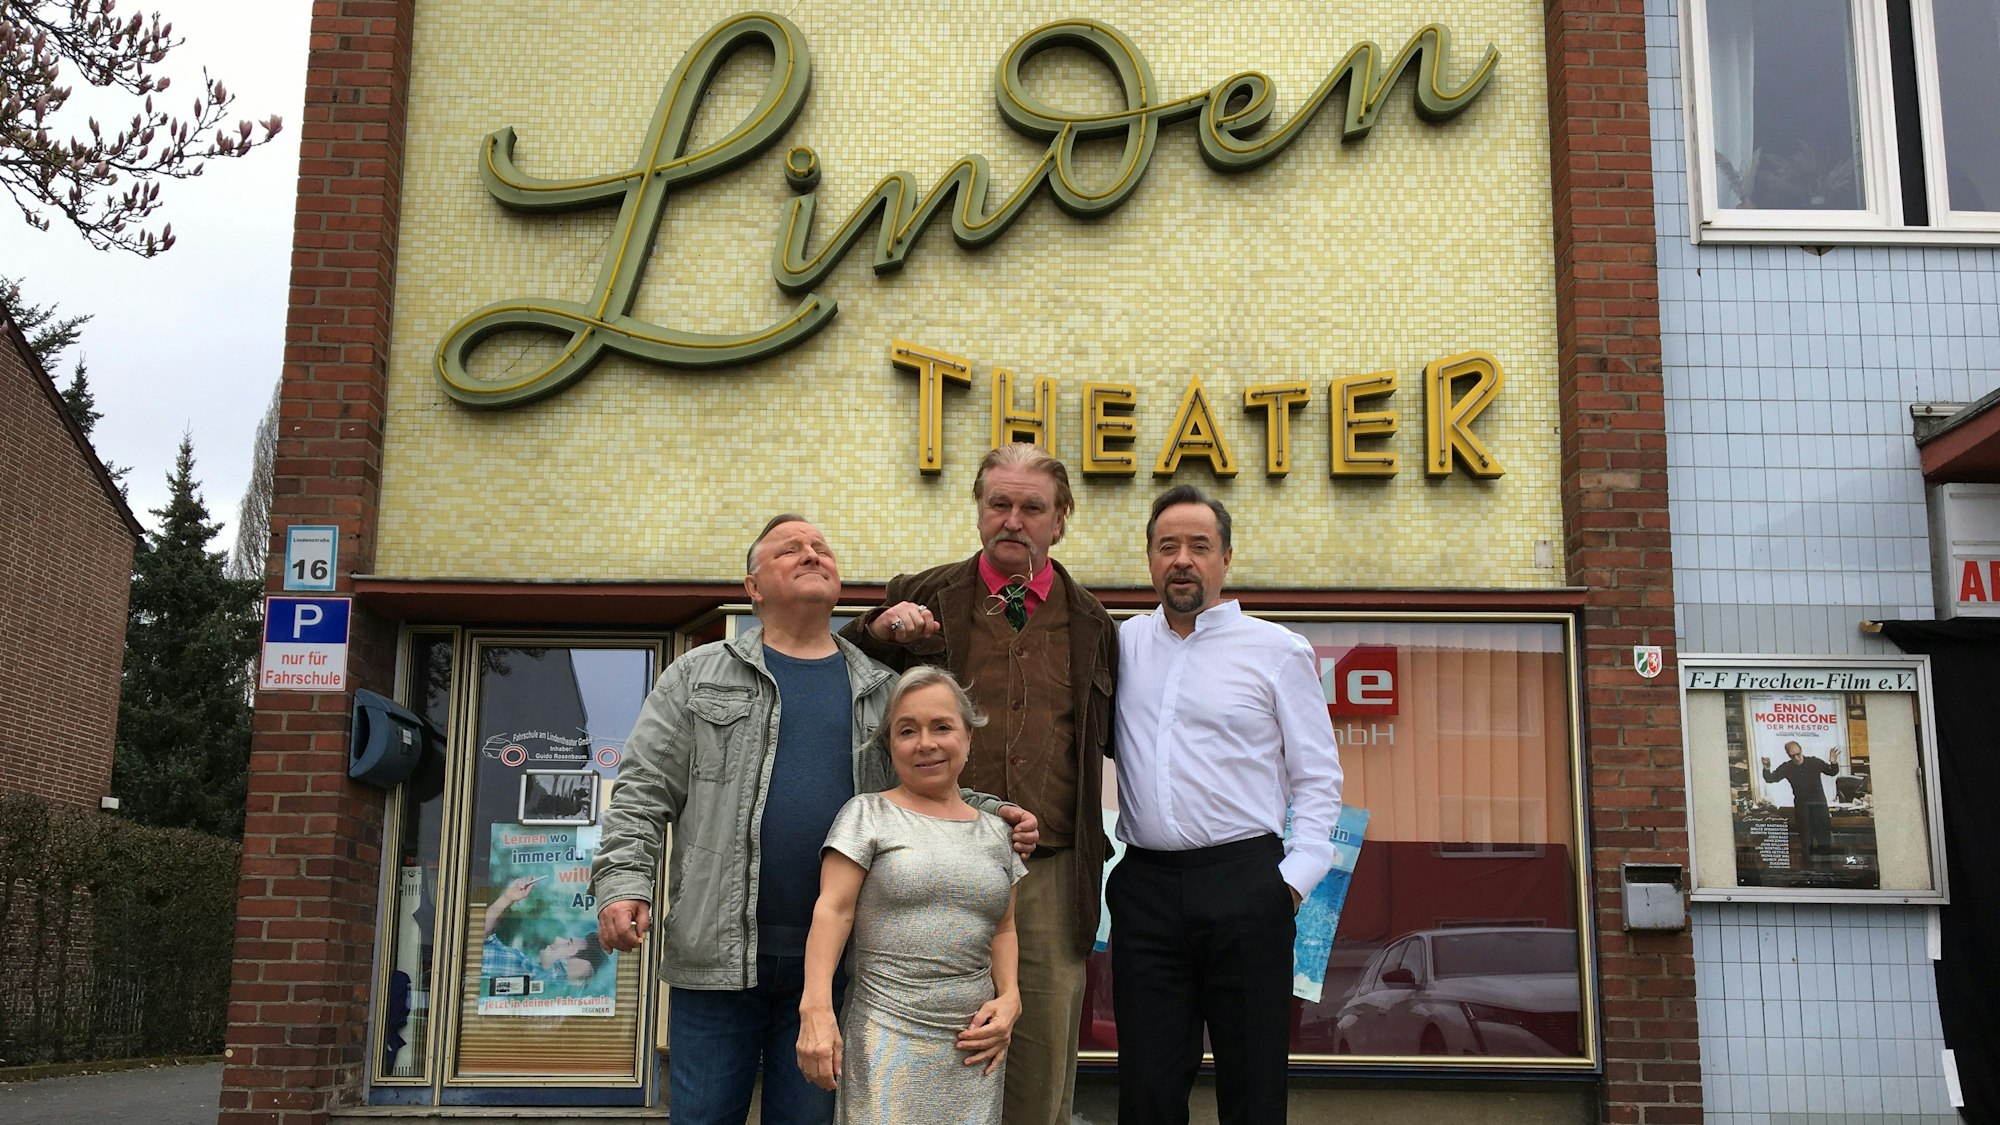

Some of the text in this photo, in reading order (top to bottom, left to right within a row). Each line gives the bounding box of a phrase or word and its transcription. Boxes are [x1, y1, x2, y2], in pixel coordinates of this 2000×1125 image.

[433, 10, 1501, 409] Linden
[890, 339, 1507, 479] THEATER
[292, 559, 328, 580] 16
[292, 604, 323, 639] P
[281, 651, 328, 665] nur für
[265, 670, 341, 685] Fahrschule
[1690, 671, 1912, 690] F-F Frechen-Film e.V.
[1773, 703, 1817, 714] ENNIO
[1755, 712, 1837, 724] MORRICONE
[512, 730, 538, 742] Fahrschule
[538, 731, 547, 739] am
[503, 834, 568, 845] Lernen wo
[512, 847, 585, 864] immer du
[559, 866, 592, 883] will
[572, 892, 596, 911] Ap
[484, 995, 610, 1011] jetzt in deiner Fahrschule
